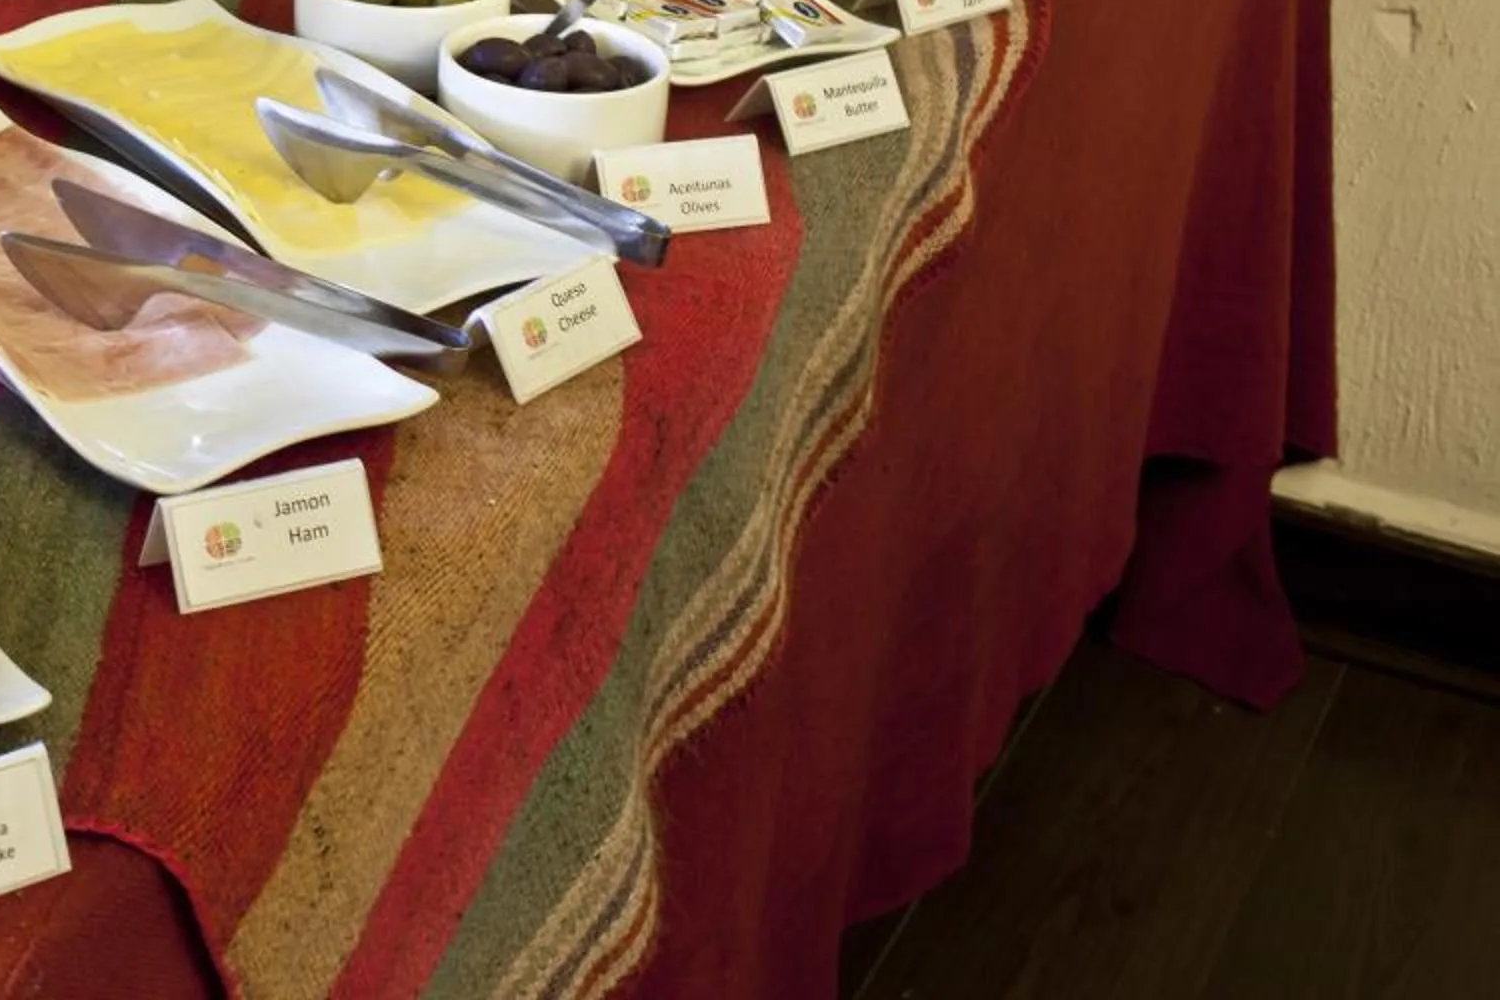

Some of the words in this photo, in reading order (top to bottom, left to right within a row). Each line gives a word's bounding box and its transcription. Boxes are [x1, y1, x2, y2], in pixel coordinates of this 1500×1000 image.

[823, 75, 887, 100] Mantequilla
[844, 100, 878, 117] Butter
[669, 178, 732, 195] Aceitunas
[680, 201, 721, 216] Olives
[551, 282, 587, 308] Queso
[558, 304, 597, 332] Cheese
[275, 492, 331, 518] Jamon
[289, 523, 329, 545] Ham
